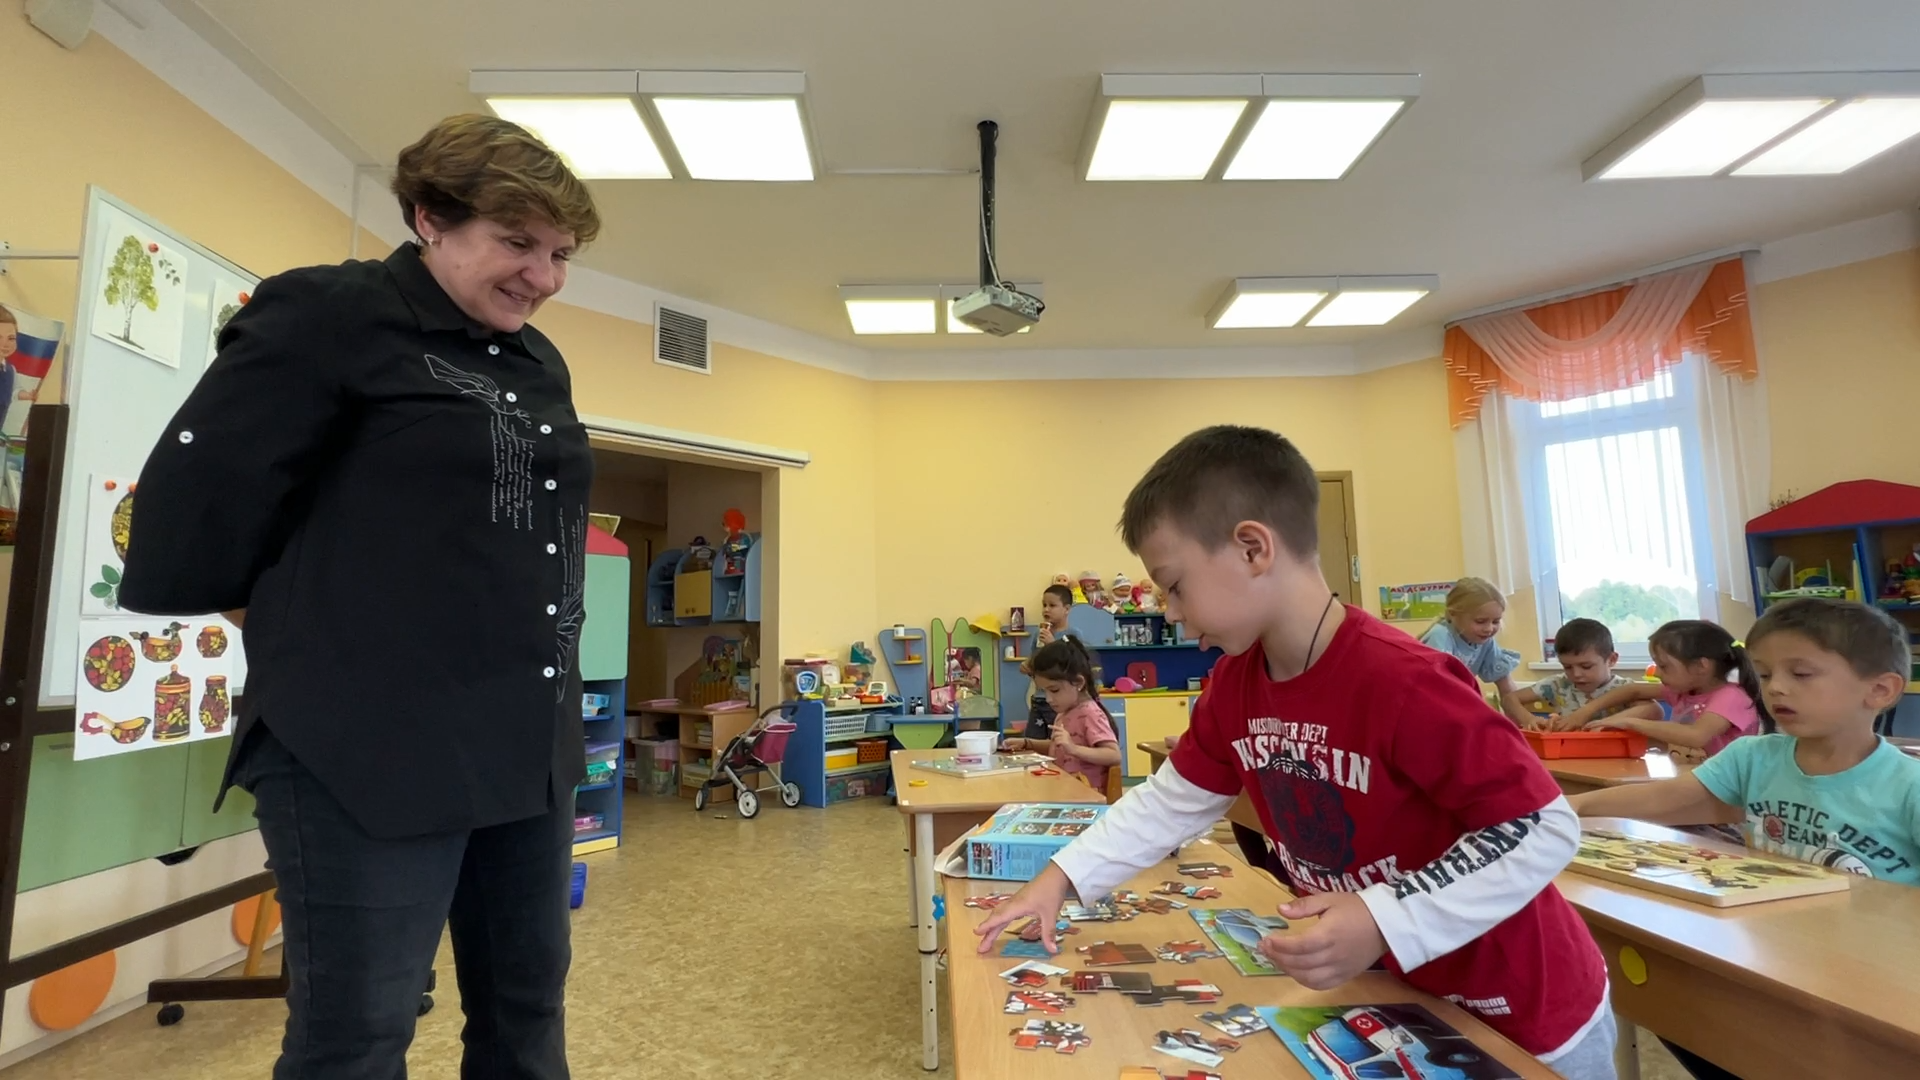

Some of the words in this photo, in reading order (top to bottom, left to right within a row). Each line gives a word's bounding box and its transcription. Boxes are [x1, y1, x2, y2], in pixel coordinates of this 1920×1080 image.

[1300, 723, 1328, 744] DEPT
[1231, 735, 1371, 795] WSCONSIN
[1782, 821, 1828, 850] EAM
[1838, 823, 1911, 873] DEPT
